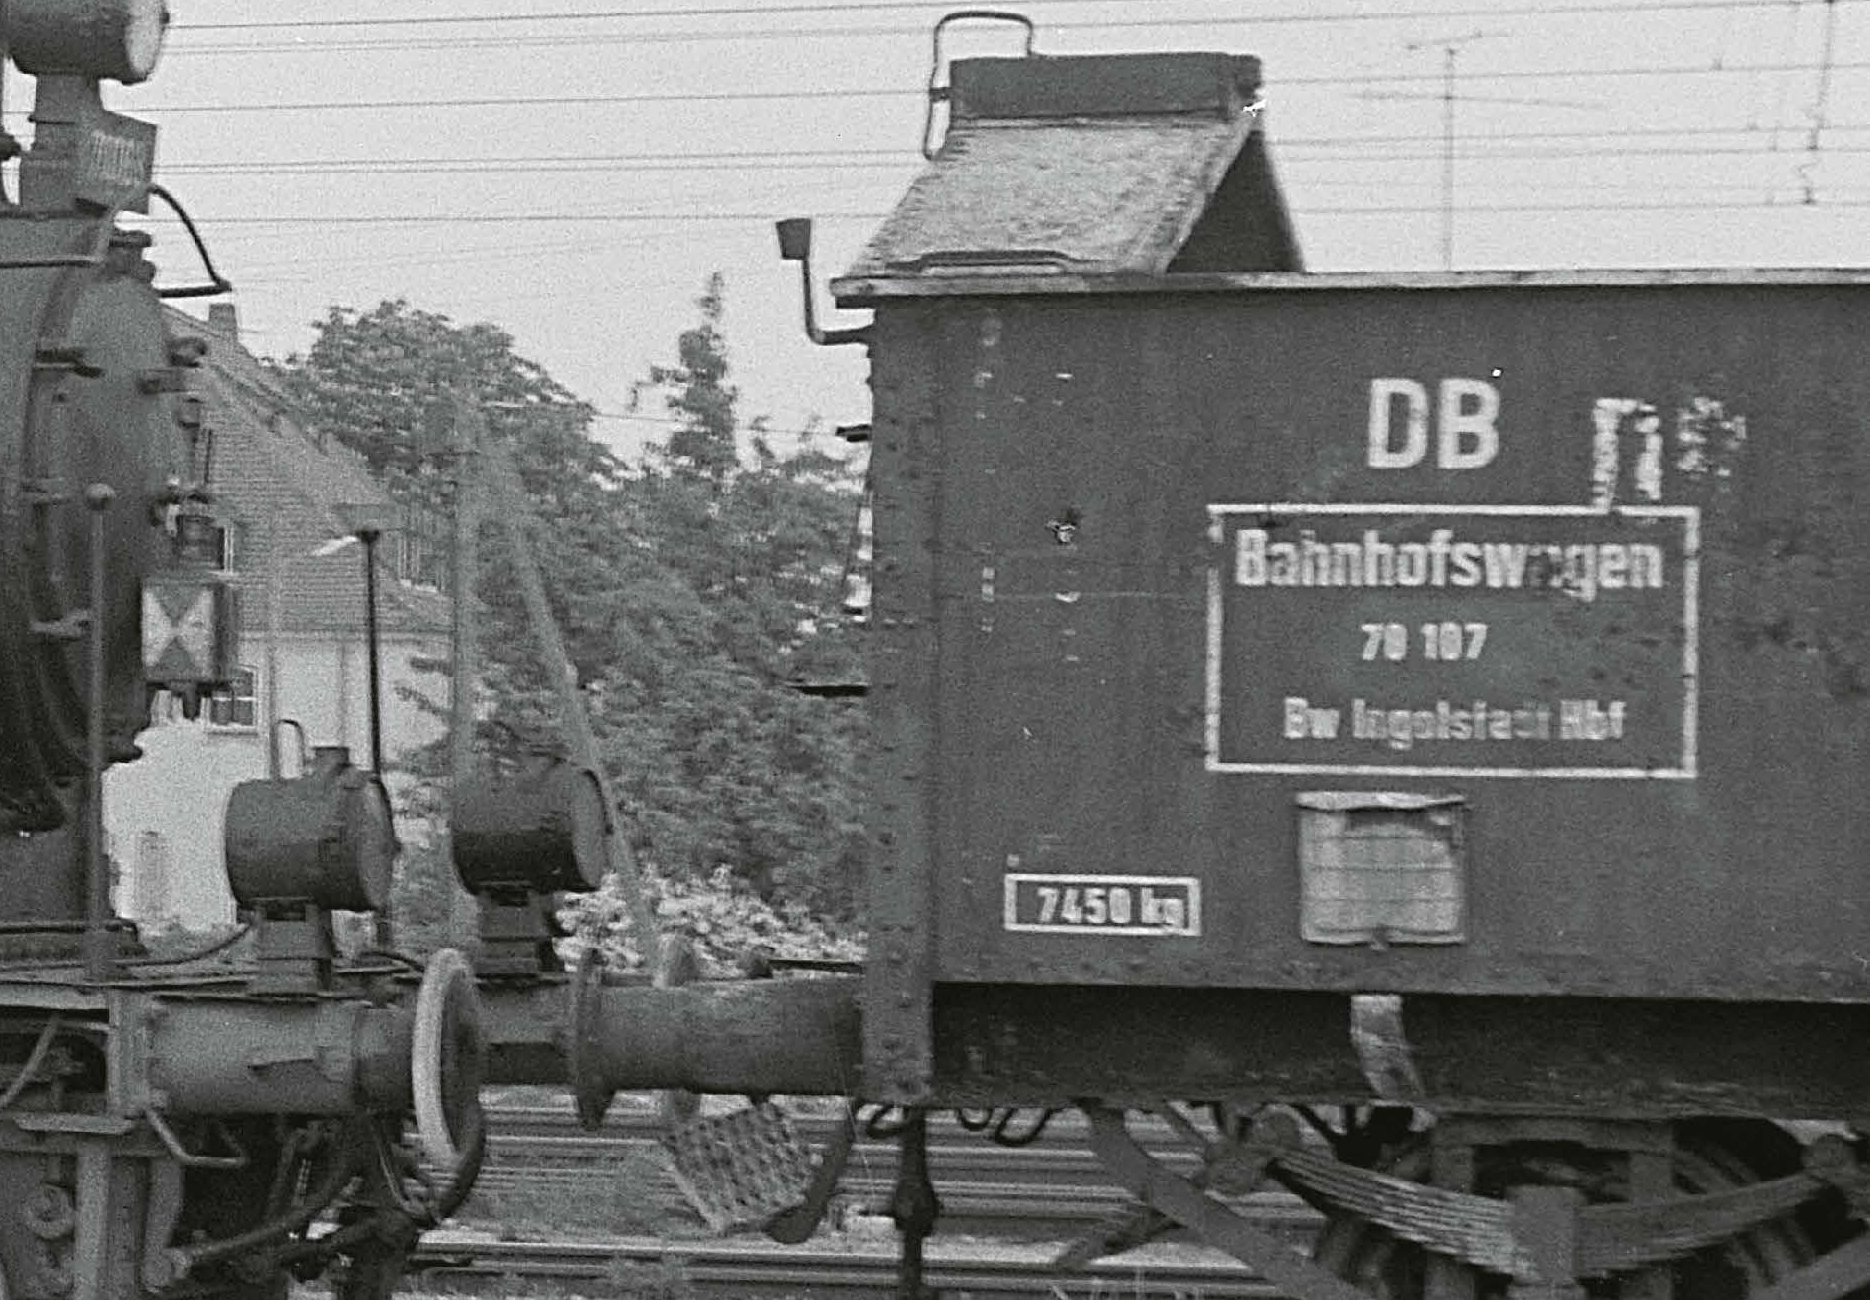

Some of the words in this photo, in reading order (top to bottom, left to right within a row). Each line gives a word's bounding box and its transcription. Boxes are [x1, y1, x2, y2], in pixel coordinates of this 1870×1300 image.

[1368, 378, 1500, 469] DB
[1284, 698, 1340, 740] Bw
[1560, 699, 1627, 740] Hbf
[1036, 887, 1131, 925] 7450
[1140, 887, 1185, 930] kg
